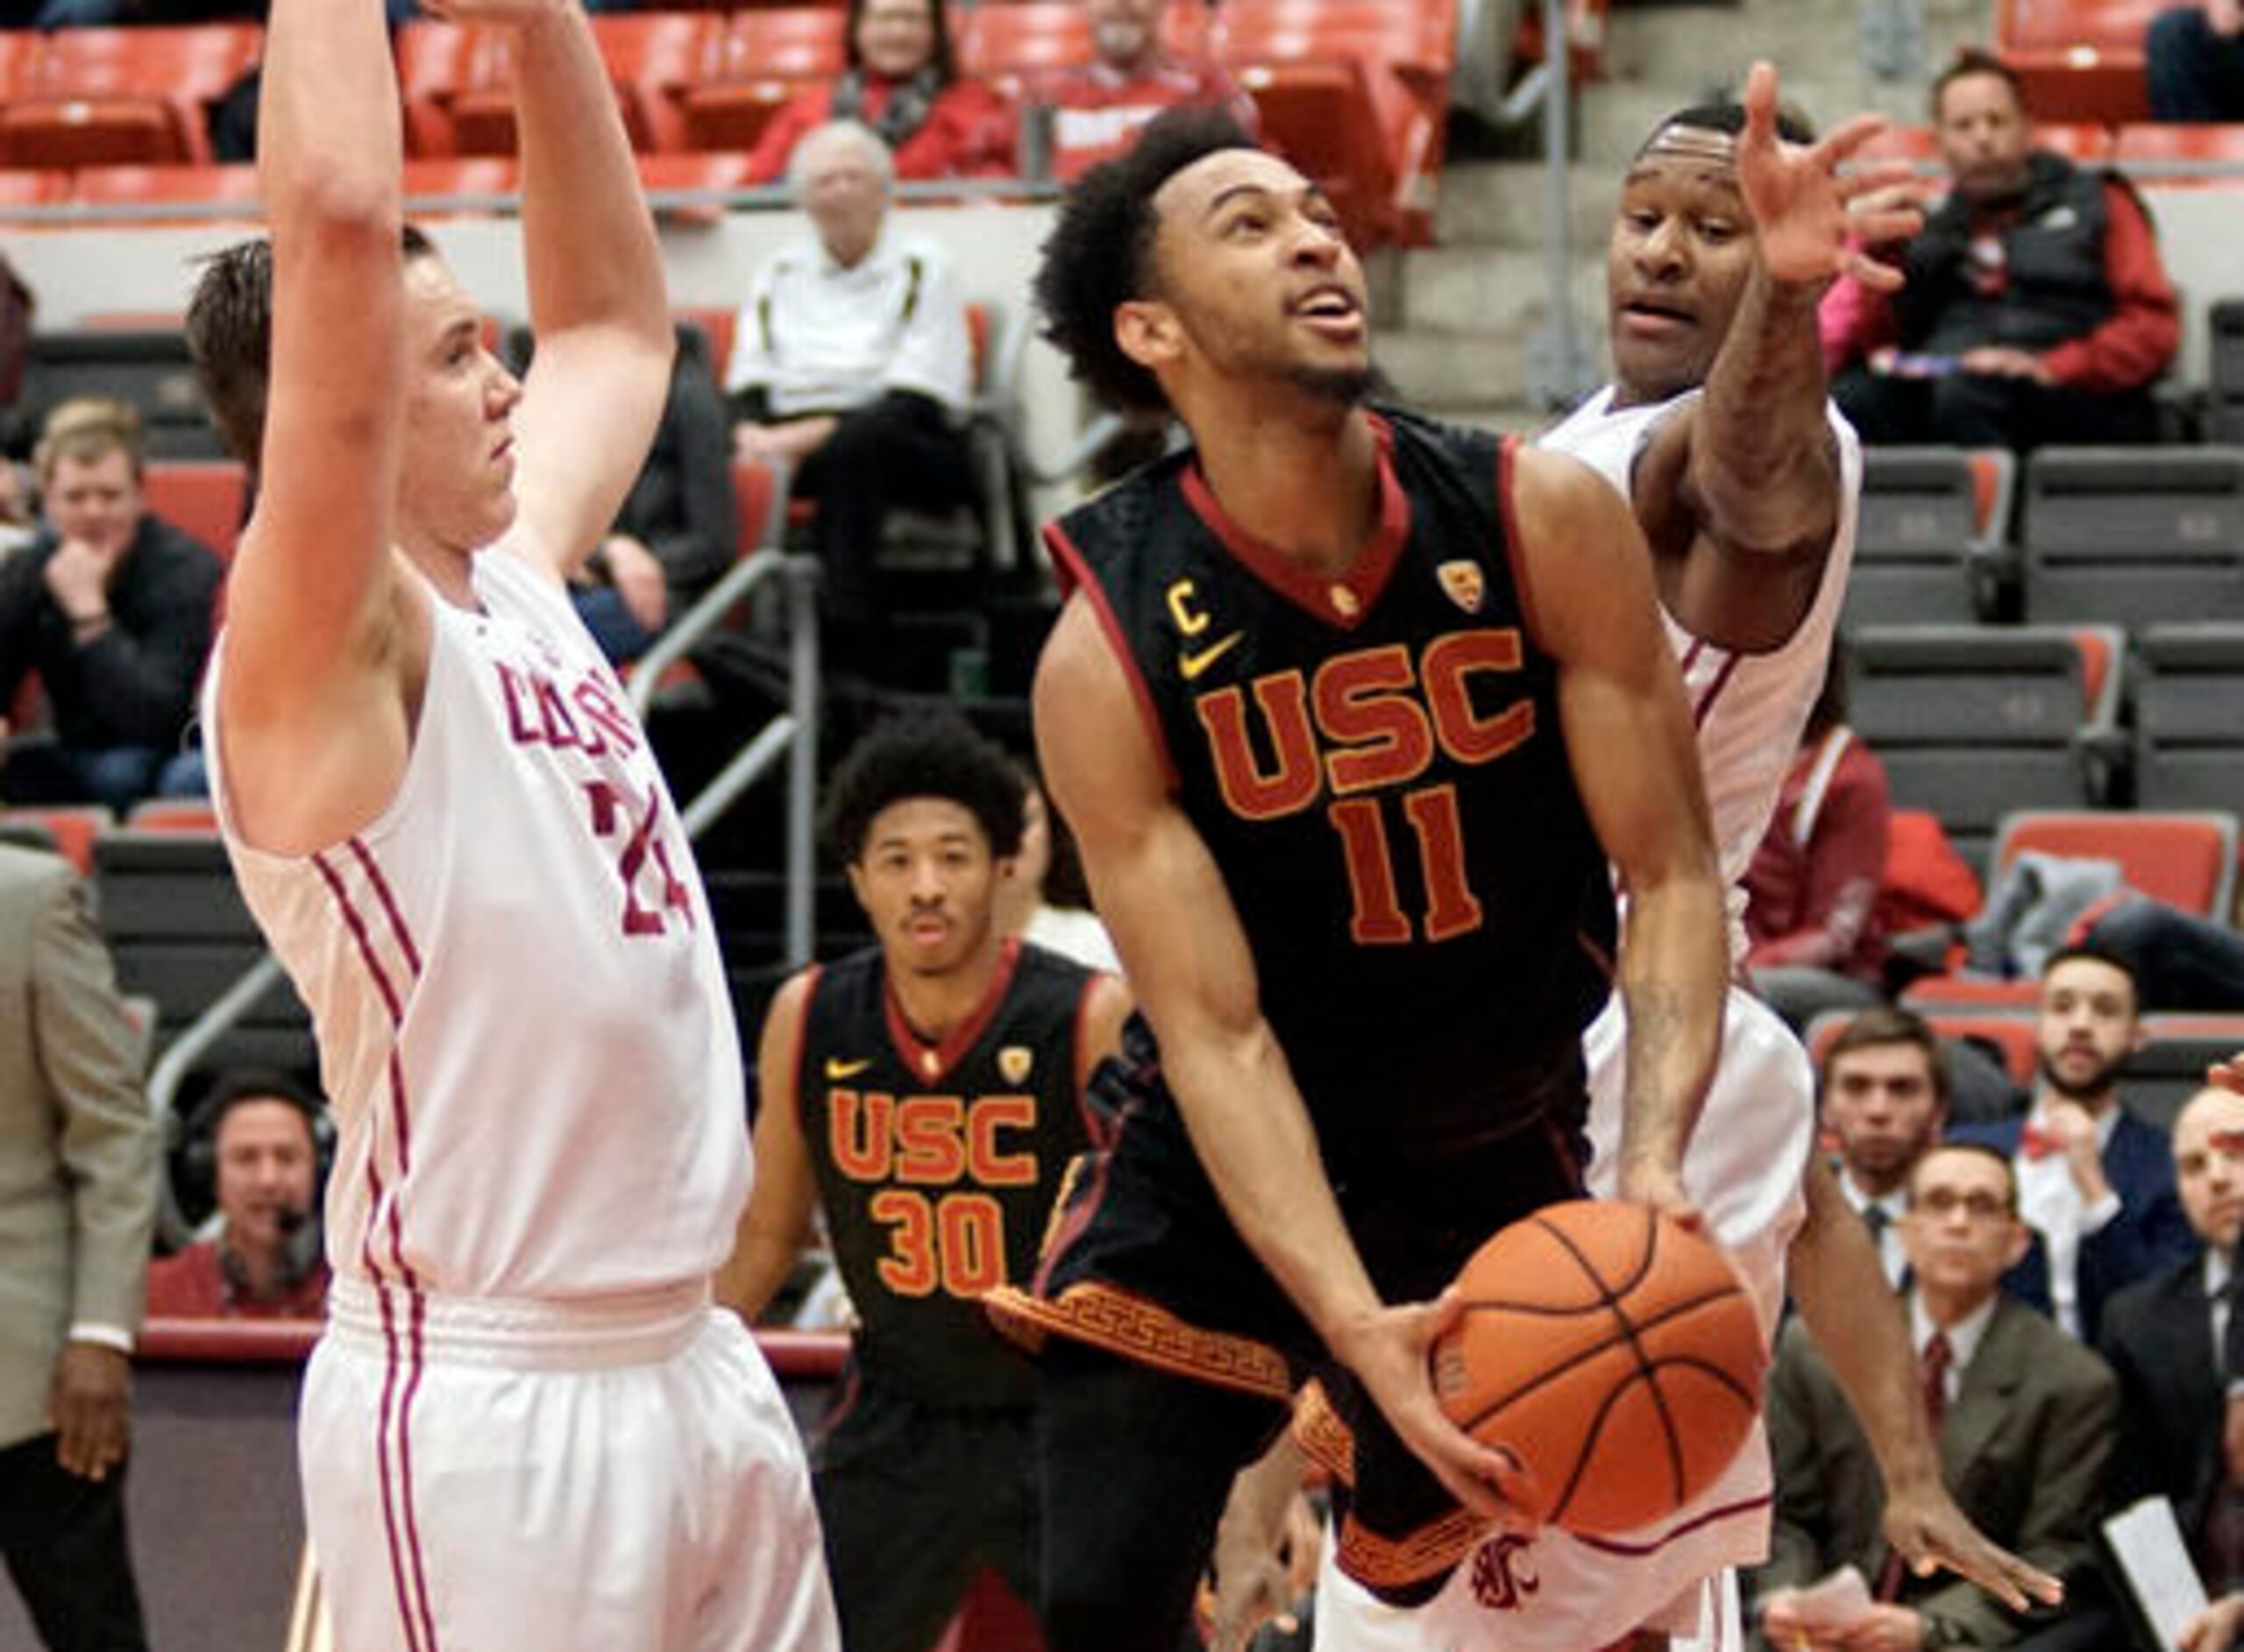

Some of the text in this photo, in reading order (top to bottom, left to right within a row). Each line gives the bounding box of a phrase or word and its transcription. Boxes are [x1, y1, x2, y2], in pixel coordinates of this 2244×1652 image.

[1167, 578, 1209, 634] C
[1196, 628, 1535, 820] USC
[1328, 783, 1483, 943] 11
[828, 1088, 1039, 1183] USC
[870, 1188, 1007, 1298] 30
